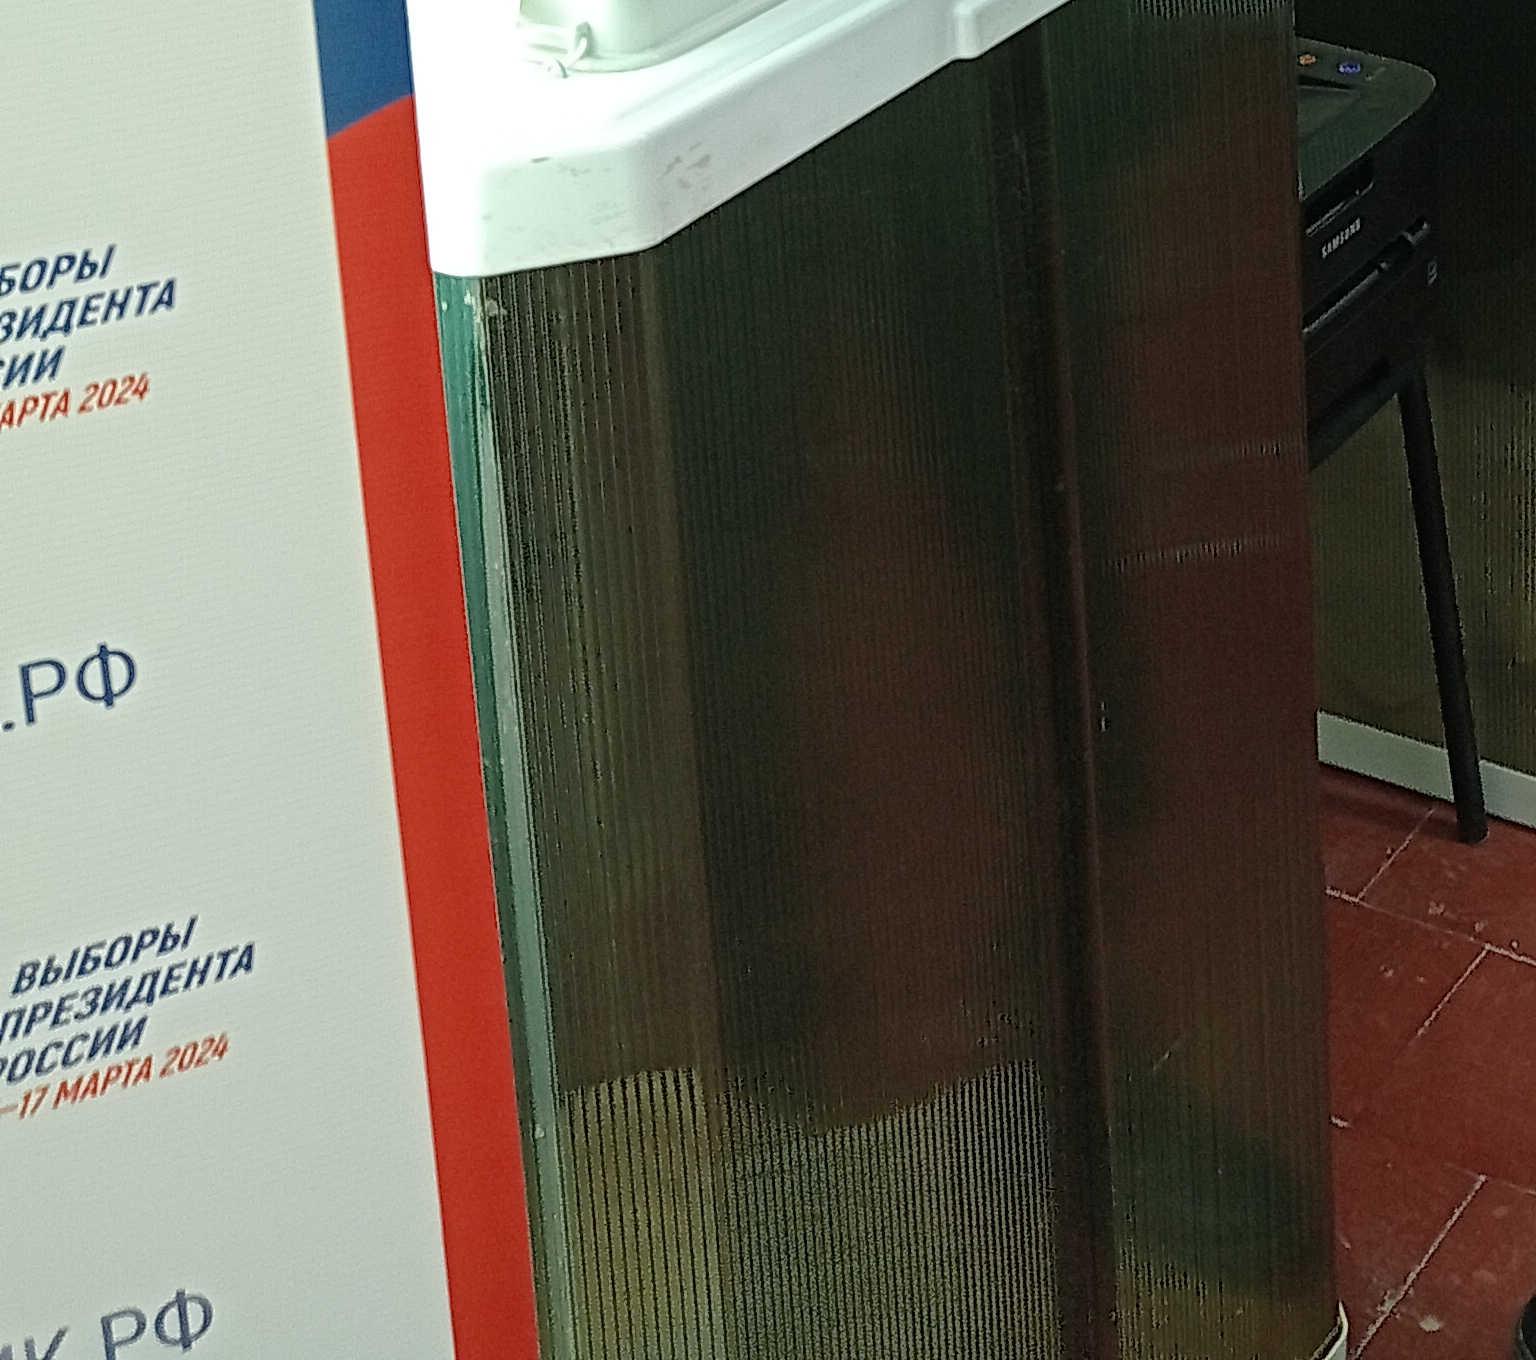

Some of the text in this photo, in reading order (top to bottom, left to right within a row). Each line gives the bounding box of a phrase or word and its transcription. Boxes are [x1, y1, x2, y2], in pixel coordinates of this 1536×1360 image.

[0, 345, 67, 390] ИИ
[0, 371, 150, 429] АРТА 2024
[0, 940, 256, 1044] ПРЕЗИДЕНТА
[10, 913, 199, 998] ВЫБОРЫ
[52, 1054, 153, 1110] МАРТА
[158, 1030, 229, 1079] 2024
